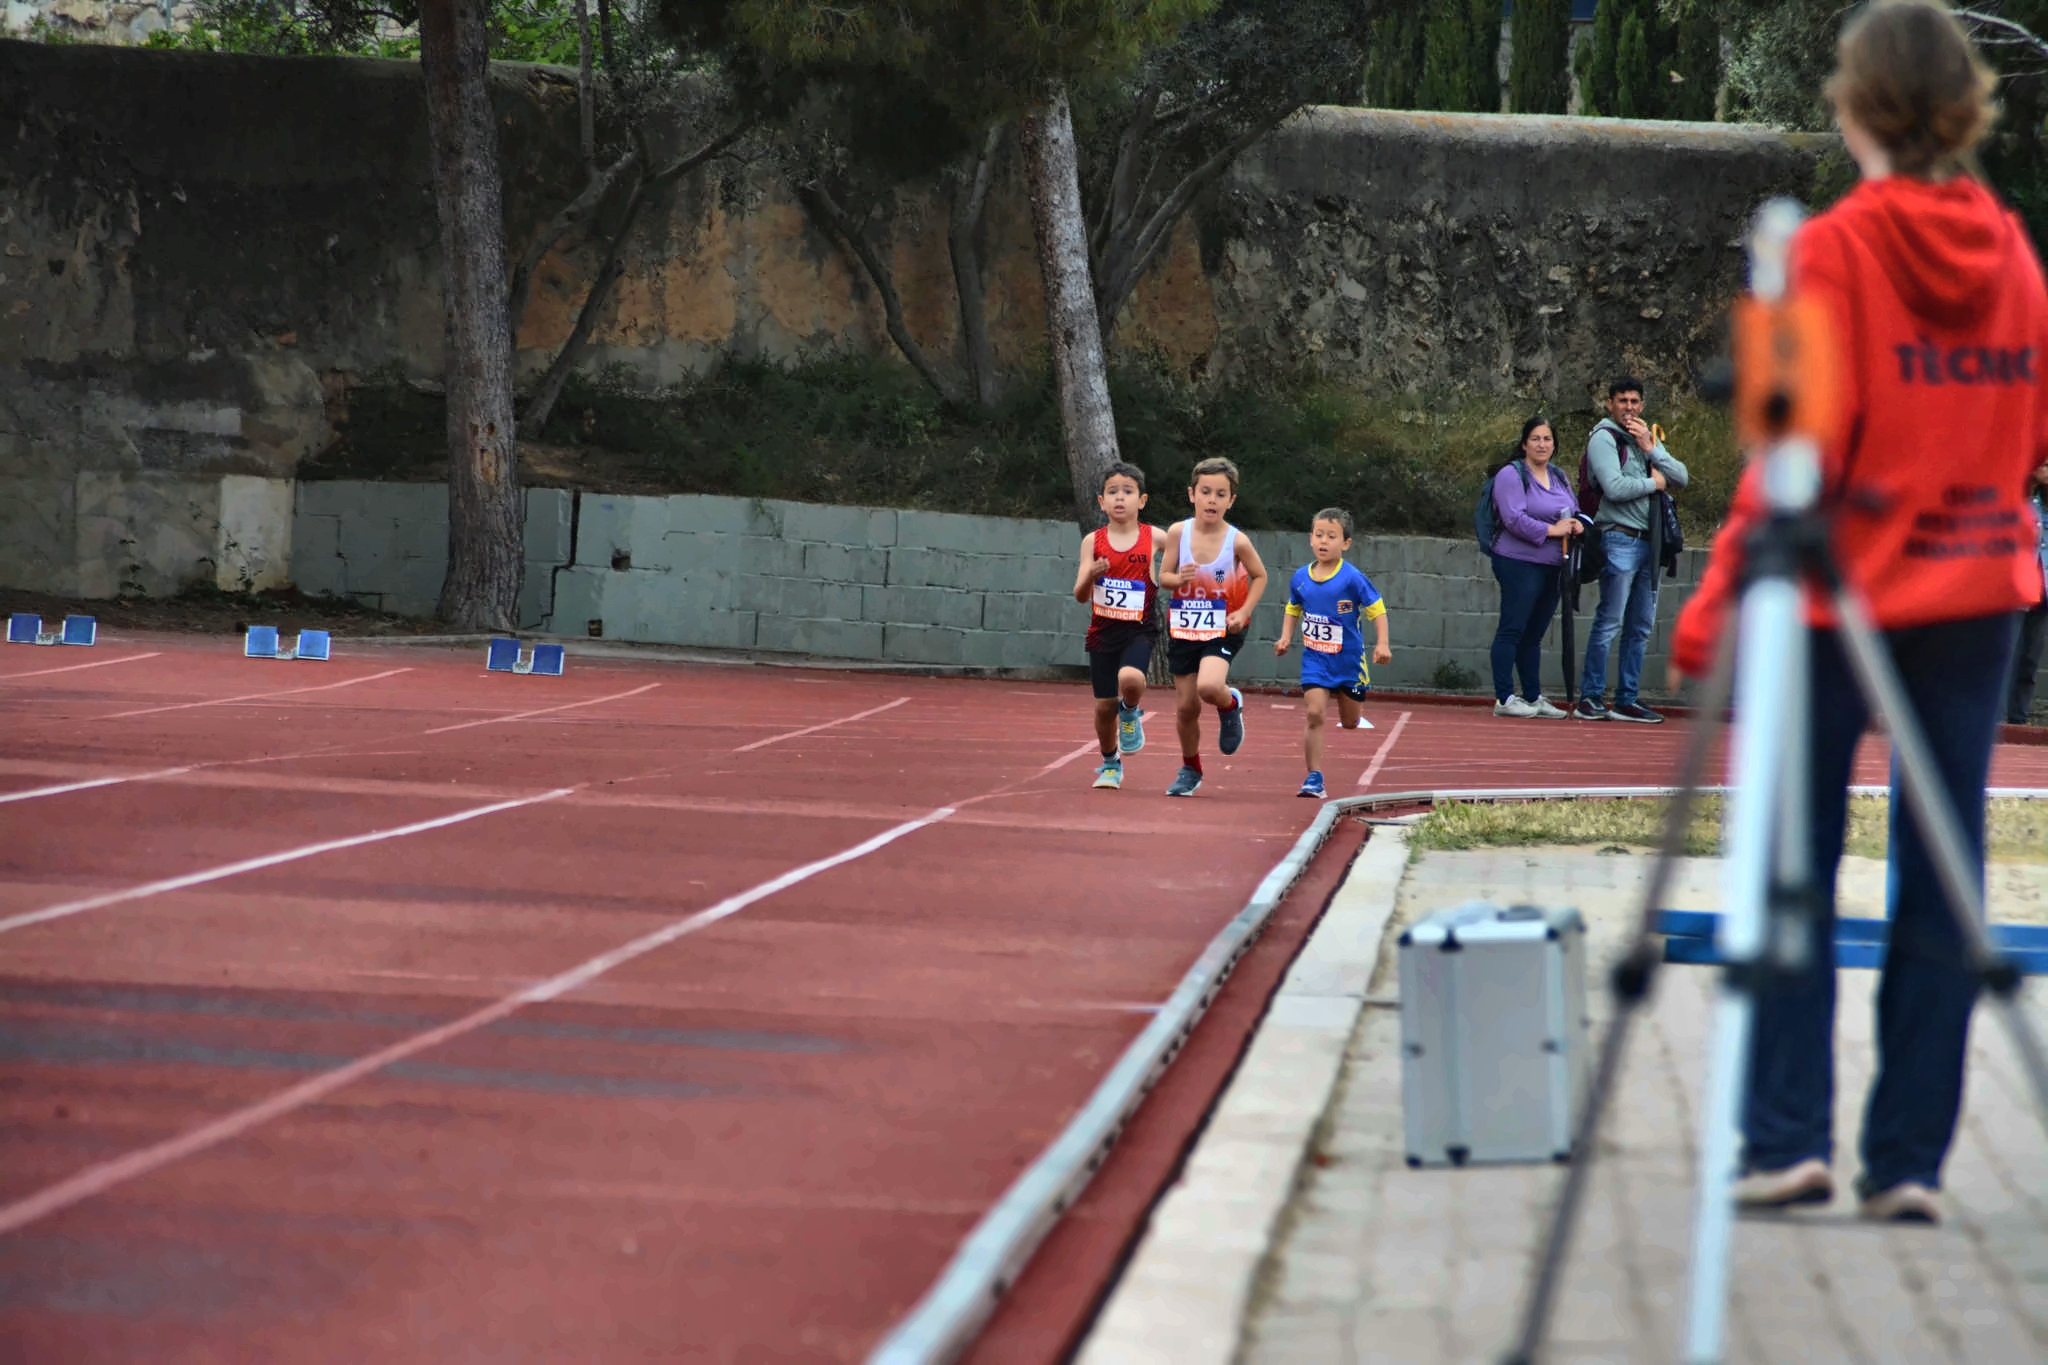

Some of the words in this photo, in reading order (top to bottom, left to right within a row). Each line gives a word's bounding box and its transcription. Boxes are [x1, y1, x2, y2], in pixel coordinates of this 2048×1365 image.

[1104, 589, 1127, 608] 52
[1180, 610, 1216, 629] 574
[1303, 620, 1332, 641] 243
